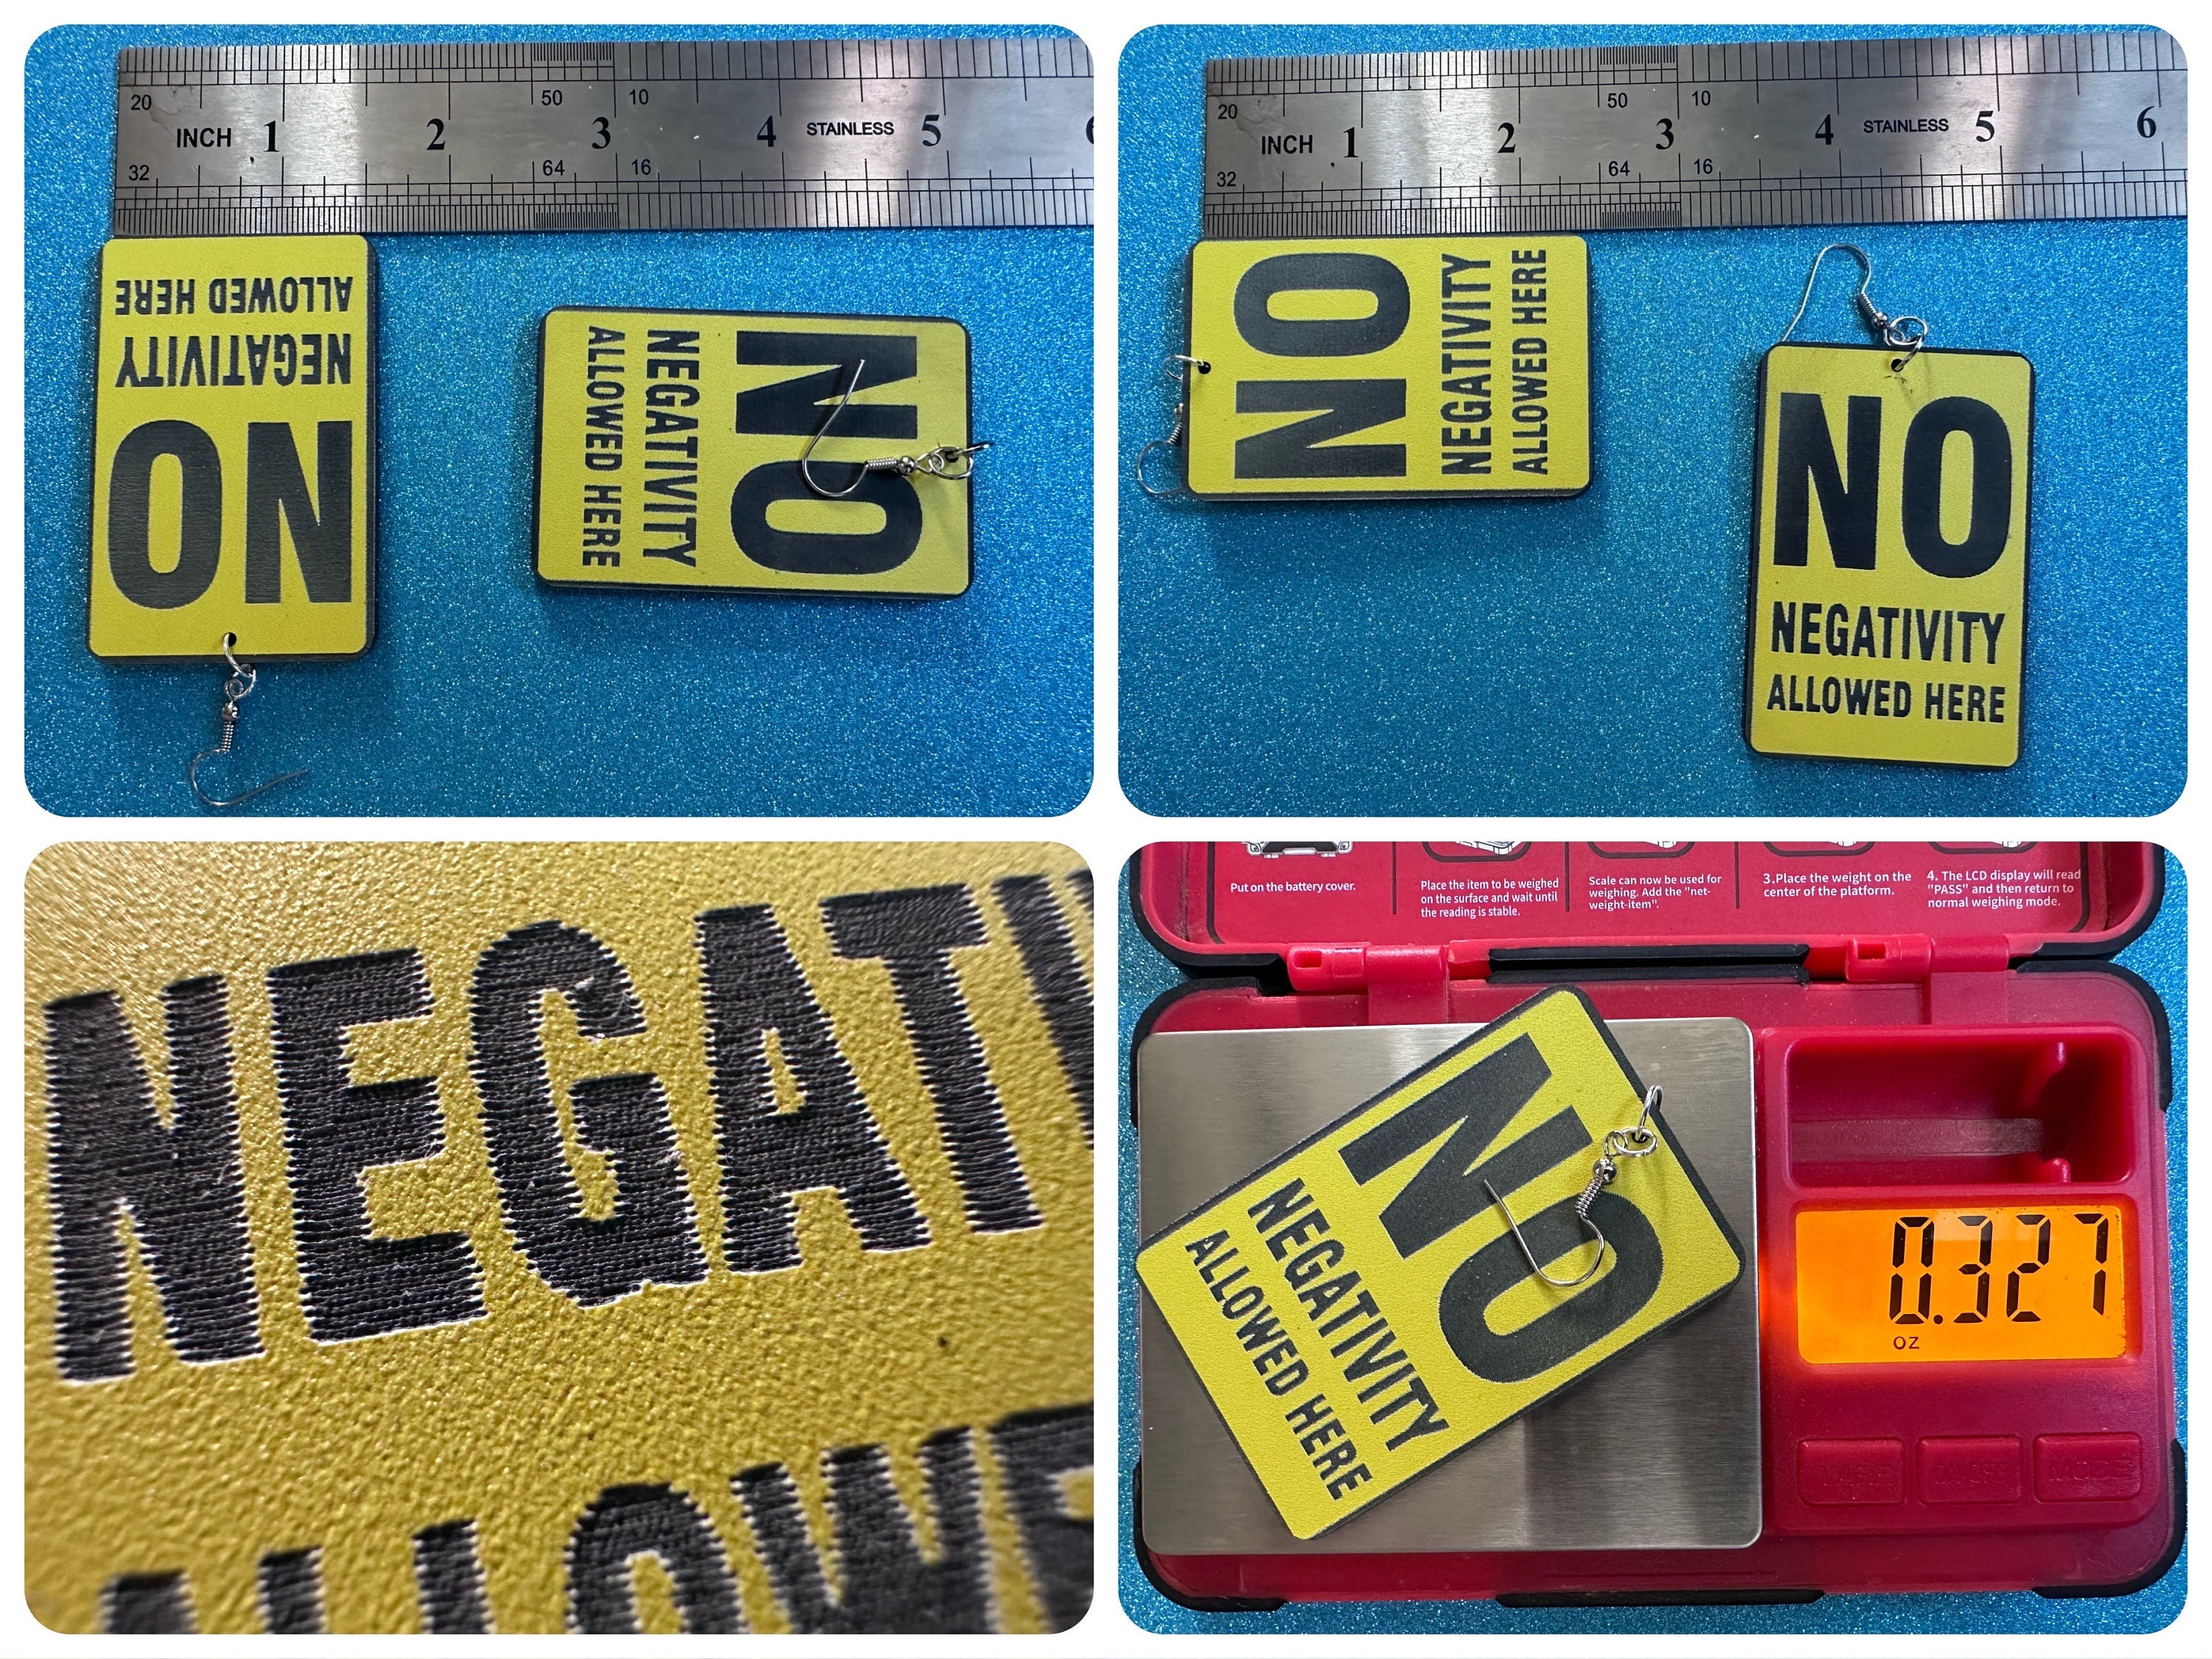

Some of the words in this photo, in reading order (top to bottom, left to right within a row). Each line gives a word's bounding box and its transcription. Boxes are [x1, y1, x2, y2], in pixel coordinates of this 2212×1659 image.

[131, 95, 151, 110] 20
[541, 90, 563, 105] 50
[629, 89, 649, 105] 10
[1607, 94, 1627, 108] 50
[1691, 91, 1711, 106] 10
[1217, 105, 1238, 119] 20
[176, 128, 231, 147] INCH
[263, 122, 279, 152] 1
[426, 119, 445, 150] 2
[592, 117, 611, 149] 3
[757, 116, 776, 147] 4
[807, 122, 894, 136] STAINLESS
[921, 115, 941, 147] 5
[1261, 136, 1312, 154] INCH
[1343, 128, 1358, 158] 1
[1498, 123, 1515, 153] 2
[1655, 119, 1674, 150] 3
[1815, 114, 1834, 145] 4
[1863, 119, 1949, 133] STAINLESS
[1975, 111, 1994, 142] 5
[2138, 106, 2156, 138] 6
[129, 166, 149, 181] 32
[542, 161, 564, 175] 64
[631, 160, 651, 175] 16
[1608, 161, 1630, 177] 64
[1694, 159, 1713, 175] 16
[1217, 173, 1237, 187] 32
[1512, 249, 1546, 324] HERE
[115, 279, 194, 316] HERE
[209, 276, 353, 314] ALLOWED
[115, 333, 351, 388] NEGATIVITY
[1234, 253, 1411, 479] NO
[1441, 254, 1492, 475] NEGATIVITY
[585, 326, 626, 471] ALLOWED
[1512, 338, 1548, 476] ALLOWED
[643, 330, 700, 568] NEGATIVITY
[731, 331, 923, 575] NO
[1773, 392, 2012, 578] NO
[108, 420, 352, 609] NO
[582, 485, 622, 568] HERE
[1771, 601, 2005, 664] NEGATIVITY
[1767, 674, 1911, 717] ALLOWED
[1925, 683, 2005, 723] HERE
[1589, 876, 1615, 885] Scale
[1665, 875, 1677, 884] be
[1680, 874, 1703, 883] used
[1707, 874, 1722, 883] for
[1810, 873, 1829, 883] the
[1832, 872, 1871, 884] weight
[1874, 873, 1889, 882] on
[1893, 872, 1911, 881] the
[1927, 870, 1938, 881] 4.
[1941, 871, 1963, 880] The
[1966, 871, 1986, 880] LCD
[1990, 870, 2030, 882] display
[2034, 869, 2053, 880] will
[2056, 869, 2081, 879] read
[1231, 883, 1248, 892] Put
[1267, 882, 1283, 891] the
[1286, 882, 1323, 893] battery
[1422, 880, 1447, 890] Place
[1449, 880, 1464, 890] the
[1467, 879, 1489, 889] item
[1492, 879, 1501, 888] to
[1504, 879, 1516, 888] be
[1518, 878, 1559, 891] weighed
[1764, 887, 1801, 897] center
[1804, 886, 1816, 896] of
[1818, 886, 1837, 896] the
[1840, 886, 1895, 898] platform.
[1928, 884, 1968, 894] "PASS"
[1972, 883, 1992, 894] and
[1996, 883, 2020, 894] then
[2025, 884, 2059, 893] return
[2062, 883, 2073, 893] to
[1421, 895, 1433, 904] on
[1436, 894, 1451, 903] the
[1454, 893, 1489, 903] surface
[1492, 893, 1509, 902] and
[1512, 892, 1532, 902] wait
[1535, 891, 1557, 902] until
[1589, 888, 1638, 899] weighing.
[1642, 888, 1662, 897] Add
[1665, 887, 1682, 896] the
[1928, 897, 1969, 908] normal
[1972, 896, 2023, 909] weighing
[2026, 897, 2061, 906] mode.
[1421, 908, 1436, 917] the
[1439, 906, 1475, 919] reading
[1478, 907, 1486, 917] is
[1489, 905, 1520, 916] stable.
[1339, 1032, 1663, 1384] NO
[1889, 1214, 2109, 1324] 0.327
[1248, 1177, 1449, 1453] NEGATIVITY
[1185, 1229, 1309, 1397] ALLOWED
[1285, 1394, 1372, 1502] HERE
